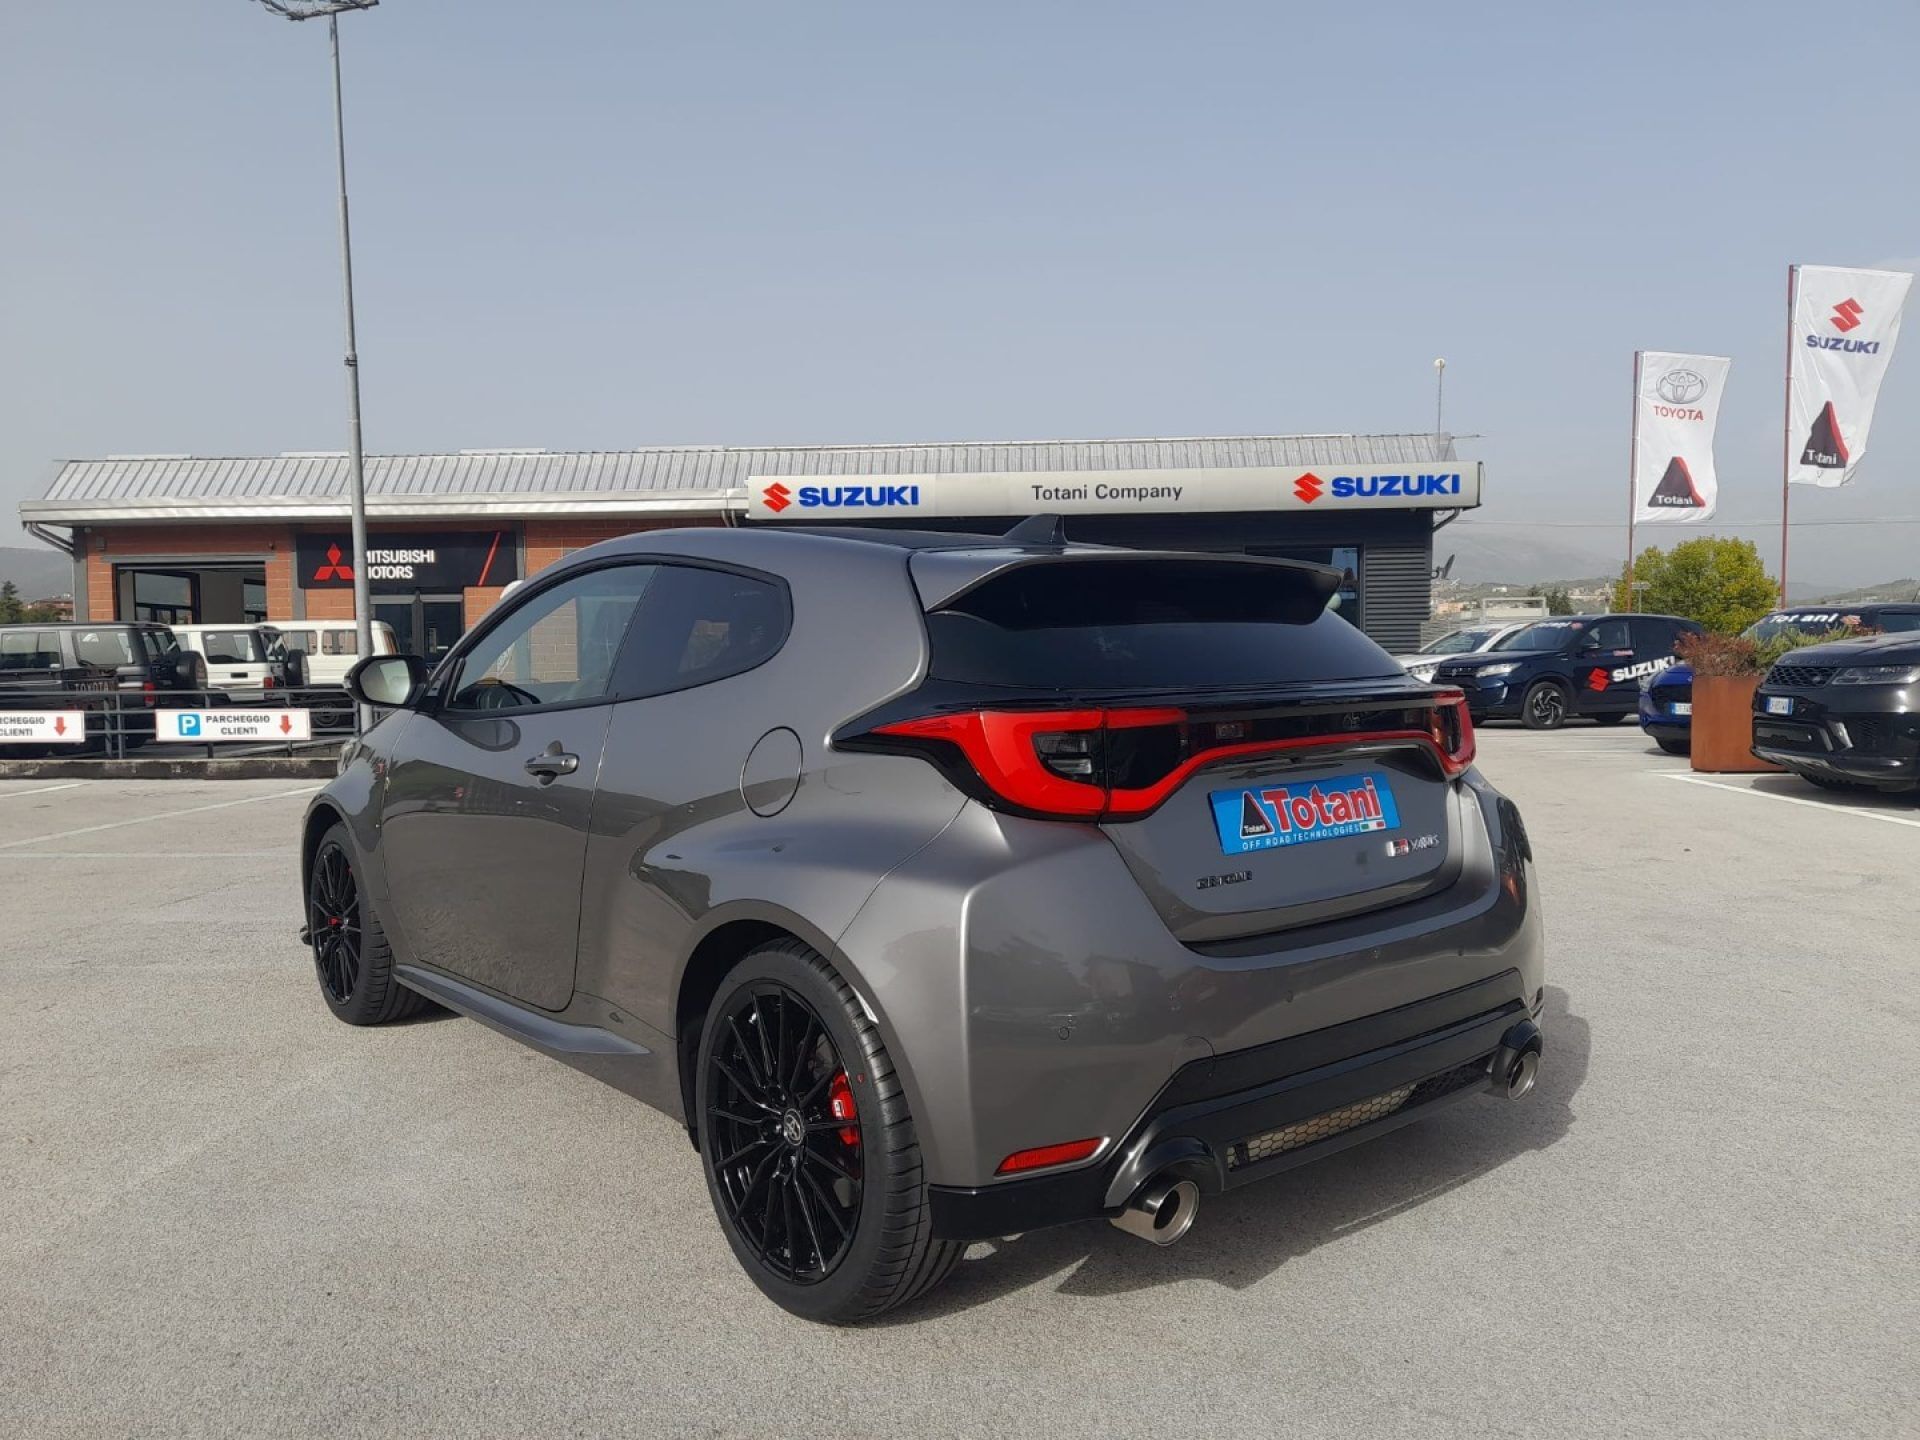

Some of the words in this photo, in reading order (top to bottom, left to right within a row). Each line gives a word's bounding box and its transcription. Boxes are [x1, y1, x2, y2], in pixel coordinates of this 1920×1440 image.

[1806, 335, 1880, 354] SUZUKI
[1653, 405, 1704, 421] TOYOTA
[1031, 484, 1087, 501] Totani
[1095, 483, 1183, 502] Company
[1331, 474, 1460, 497] SUZUKI
[798, 486, 919, 507] SUZUKI
[1656, 495, 1693, 505] Totani
[367, 566, 413, 579] OTORS
[1612, 656, 1675, 682] SUZUKI
[205, 715, 270, 724] PARCHEGGIO
[220, 727, 258, 735] CLIENTI
[1261, 777, 1383, 833] Totani
[1242, 842, 1261, 850] OFF
[1266, 835, 1291, 846] ROAD
[1293, 823, 1360, 842] TECHNOLOGIES
[1243, 824, 1266, 834] Totani
